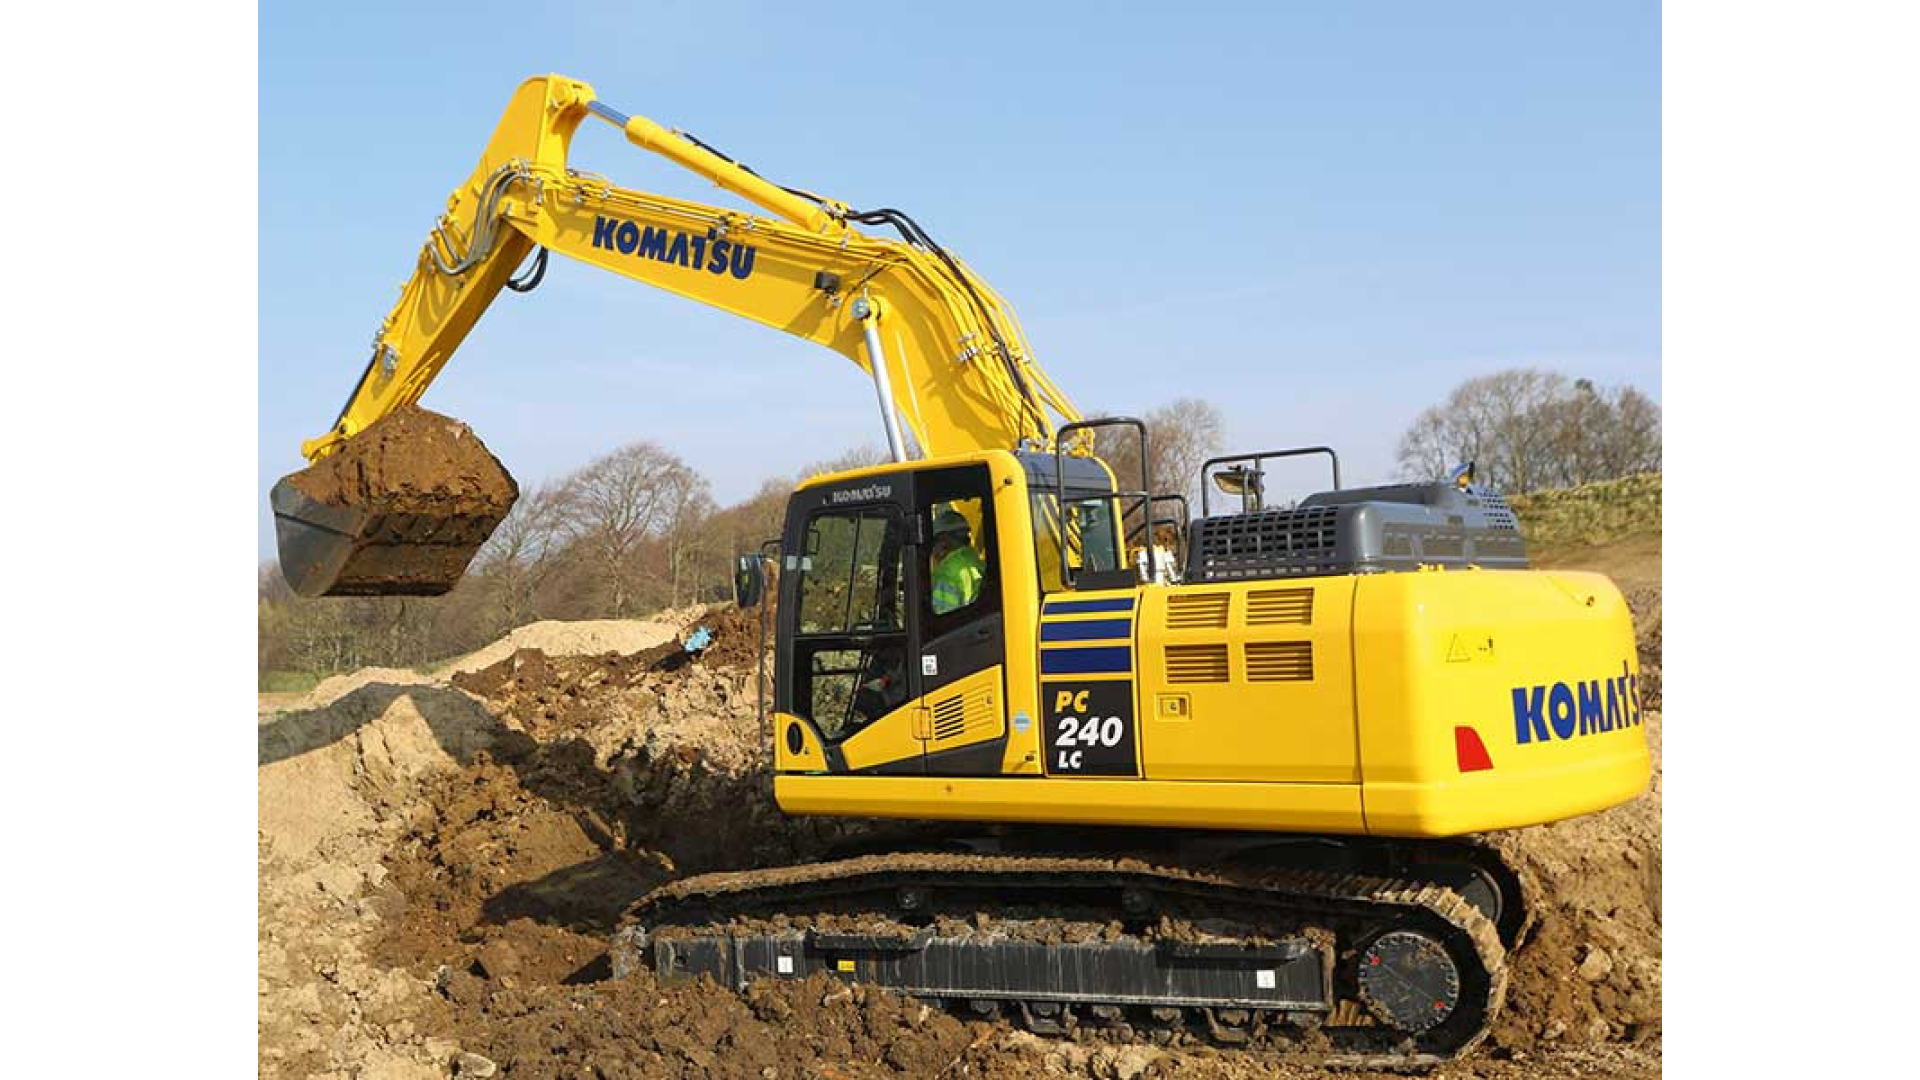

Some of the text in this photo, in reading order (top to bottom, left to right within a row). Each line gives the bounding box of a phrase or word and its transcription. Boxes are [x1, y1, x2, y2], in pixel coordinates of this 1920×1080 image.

[592, 215, 756, 280] KOMATSU
[833, 484, 892, 503] KOMATSU
[1055, 691, 1090, 713] PC
[1055, 716, 1123, 747] 240
[1058, 750, 1083, 769] LC
